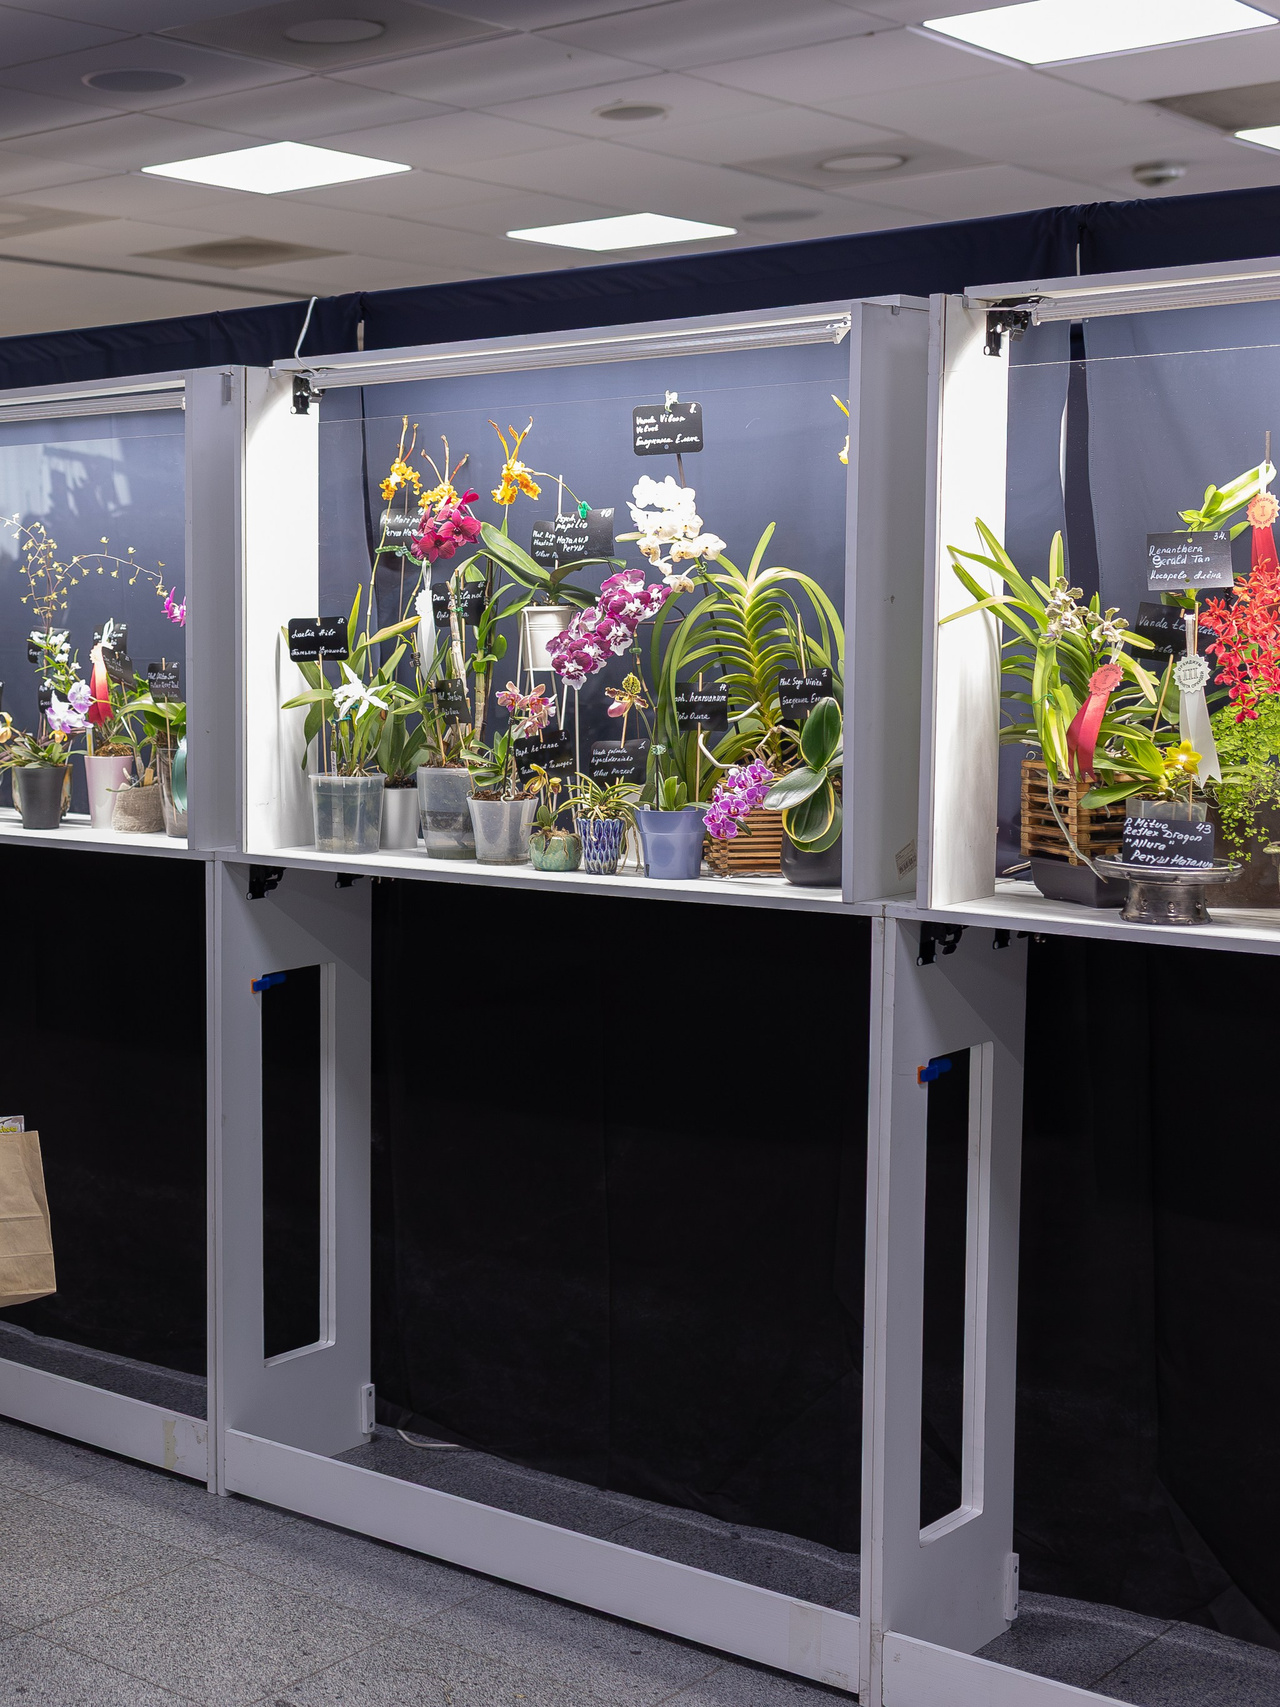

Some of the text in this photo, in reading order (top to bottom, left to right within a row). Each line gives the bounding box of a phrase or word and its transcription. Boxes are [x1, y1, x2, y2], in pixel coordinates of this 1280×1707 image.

[555, 519, 588, 533] papilio
[1191, 554, 1210, 564] Tan
[1139, 615, 1169, 629] Vanda
[1134, 817, 1169, 829] Mituo
[1195, 822, 1212, 835] 43
[1123, 826, 1203, 845] Reflex Dragon
